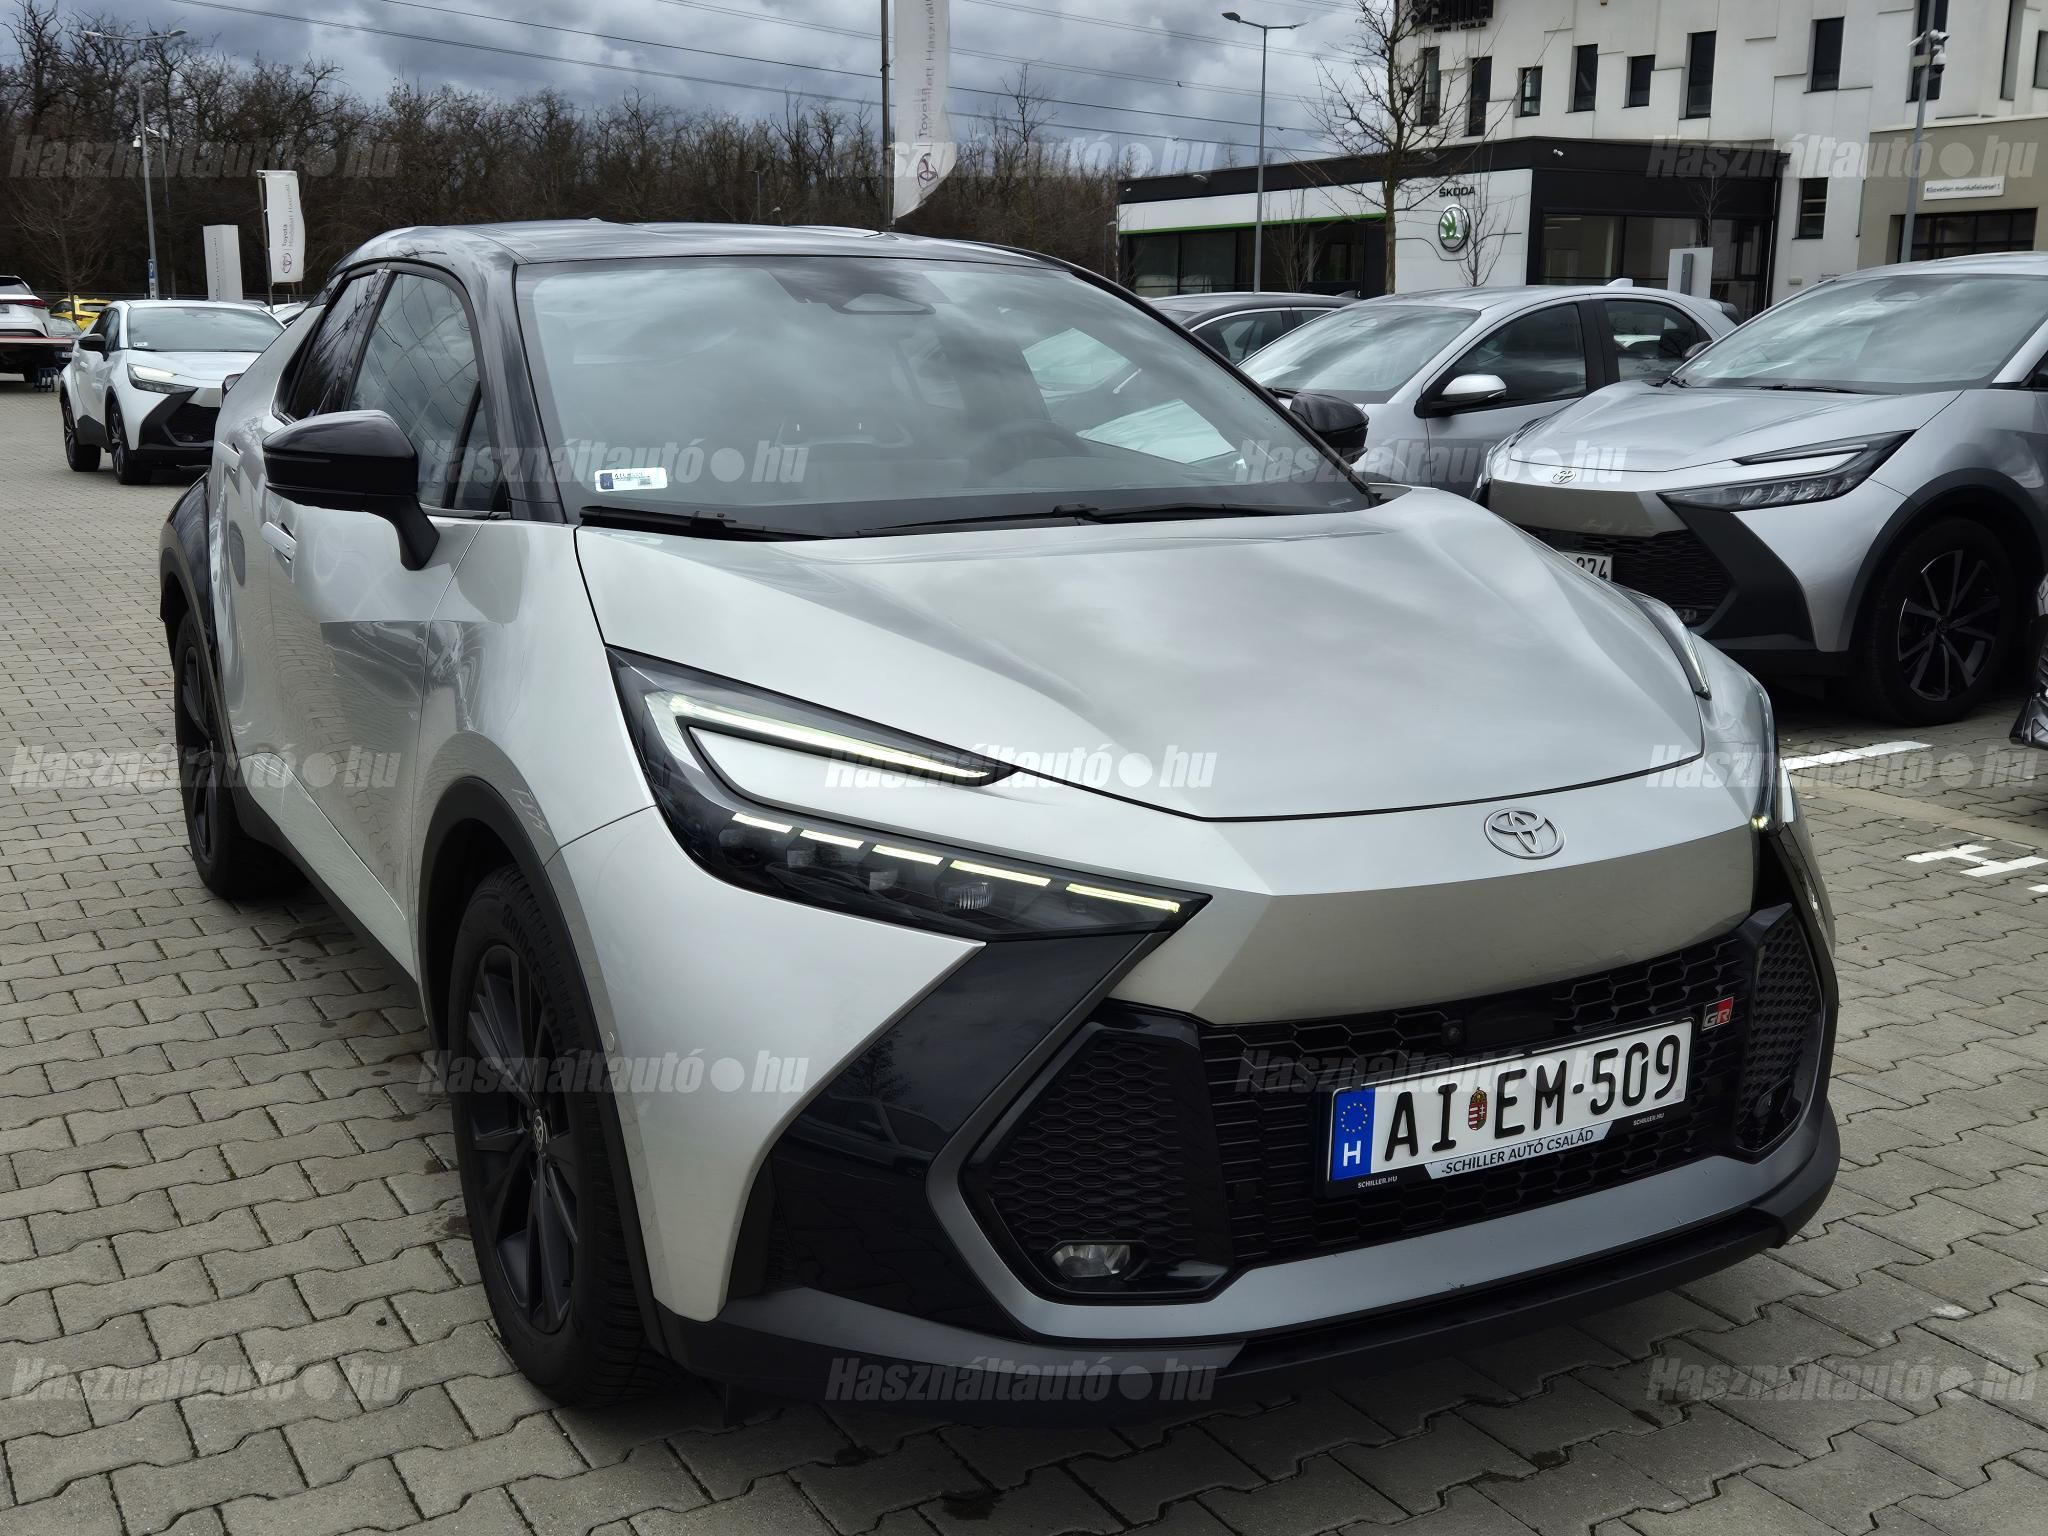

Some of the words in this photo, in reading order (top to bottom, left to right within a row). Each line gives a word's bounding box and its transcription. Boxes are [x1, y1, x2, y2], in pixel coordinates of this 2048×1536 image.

[1704, 1009, 1731, 1027] GR
[1385, 1083, 1458, 1162] AI
[1494, 1035, 1681, 1138] EM-509
[1633, 1113, 1665, 1126] SCHILLER.HU
[1343, 1140, 1362, 1167] H
[1508, 1138, 1544, 1160] AUTÓ
[1547, 1128, 1594, 1150] CSALÁD
[1358, 1176, 1398, 1189] SCHILLER.HU
